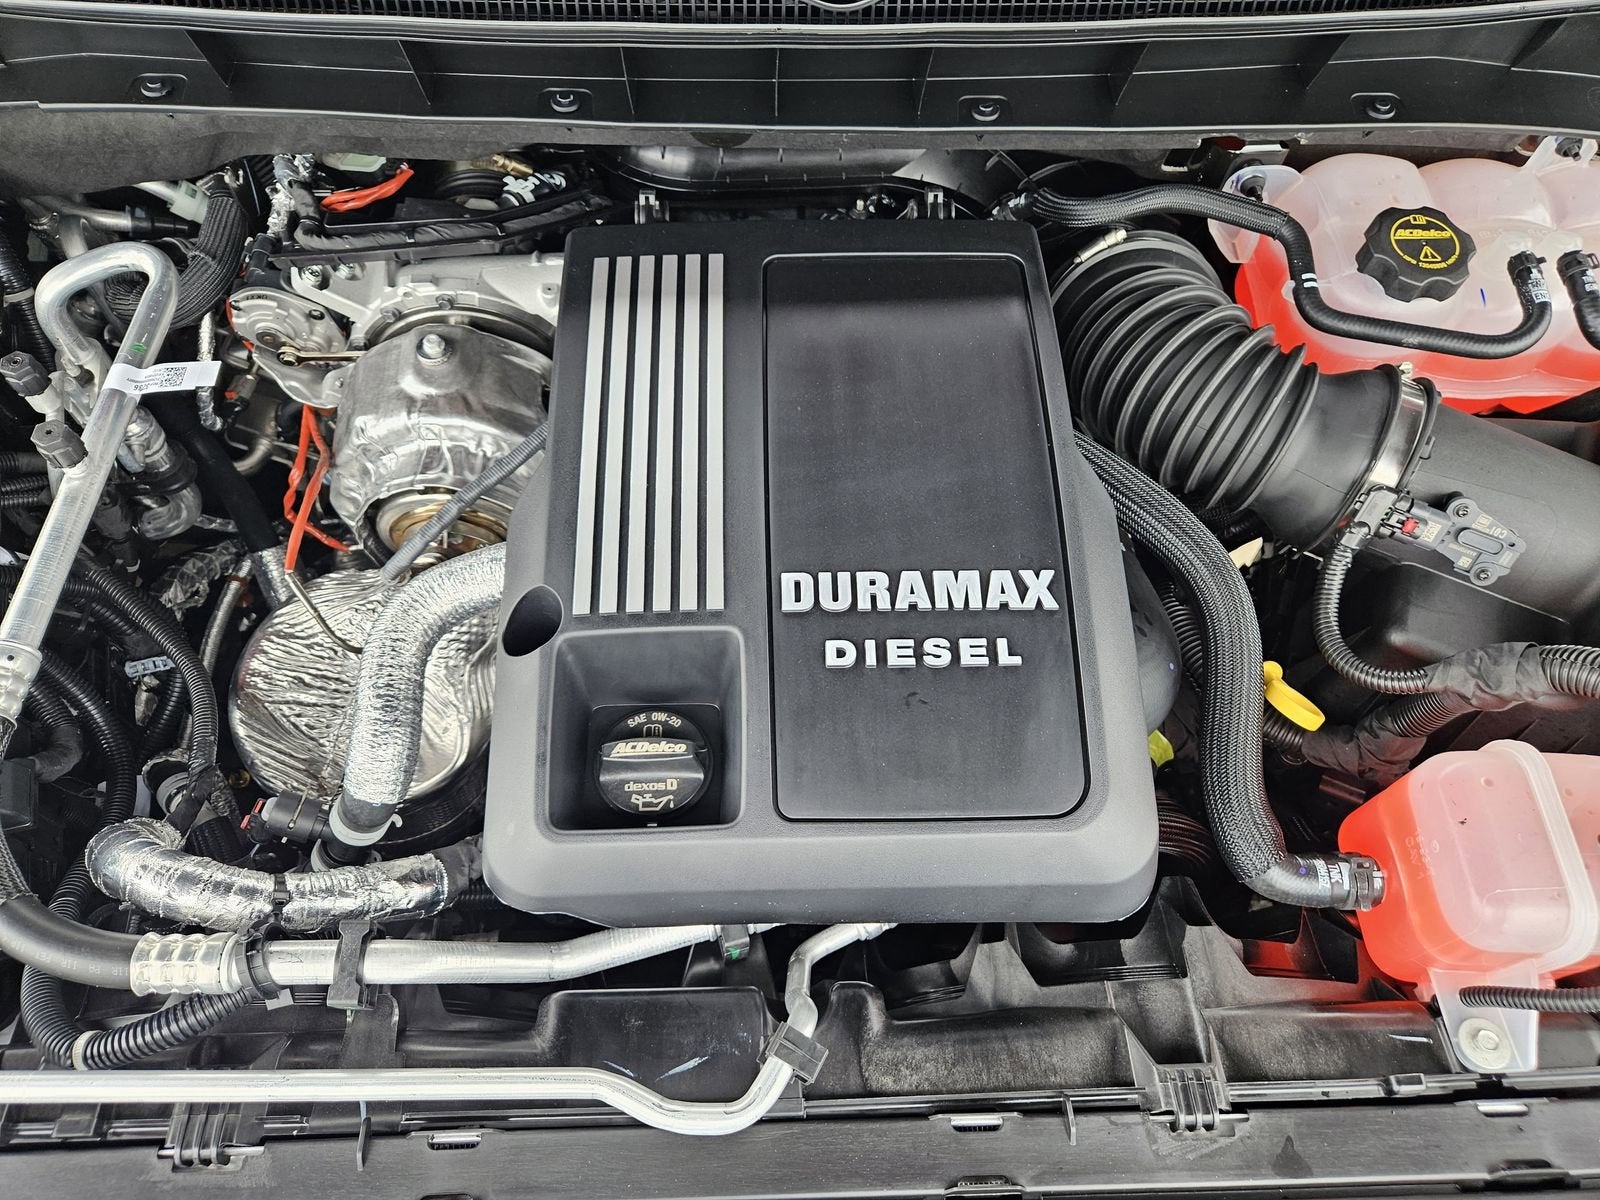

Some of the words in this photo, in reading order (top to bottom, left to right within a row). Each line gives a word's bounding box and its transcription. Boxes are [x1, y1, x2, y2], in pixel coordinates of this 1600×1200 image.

[1395, 229, 1451, 238] ACDelco
[780, 569, 1059, 613] DURAMAX
[824, 637, 1022, 668] DIESEL
[627, 713, 647, 728] SAE
[651, 712, 681, 728] 0W-20
[611, 741, 687, 755] ACDelco
